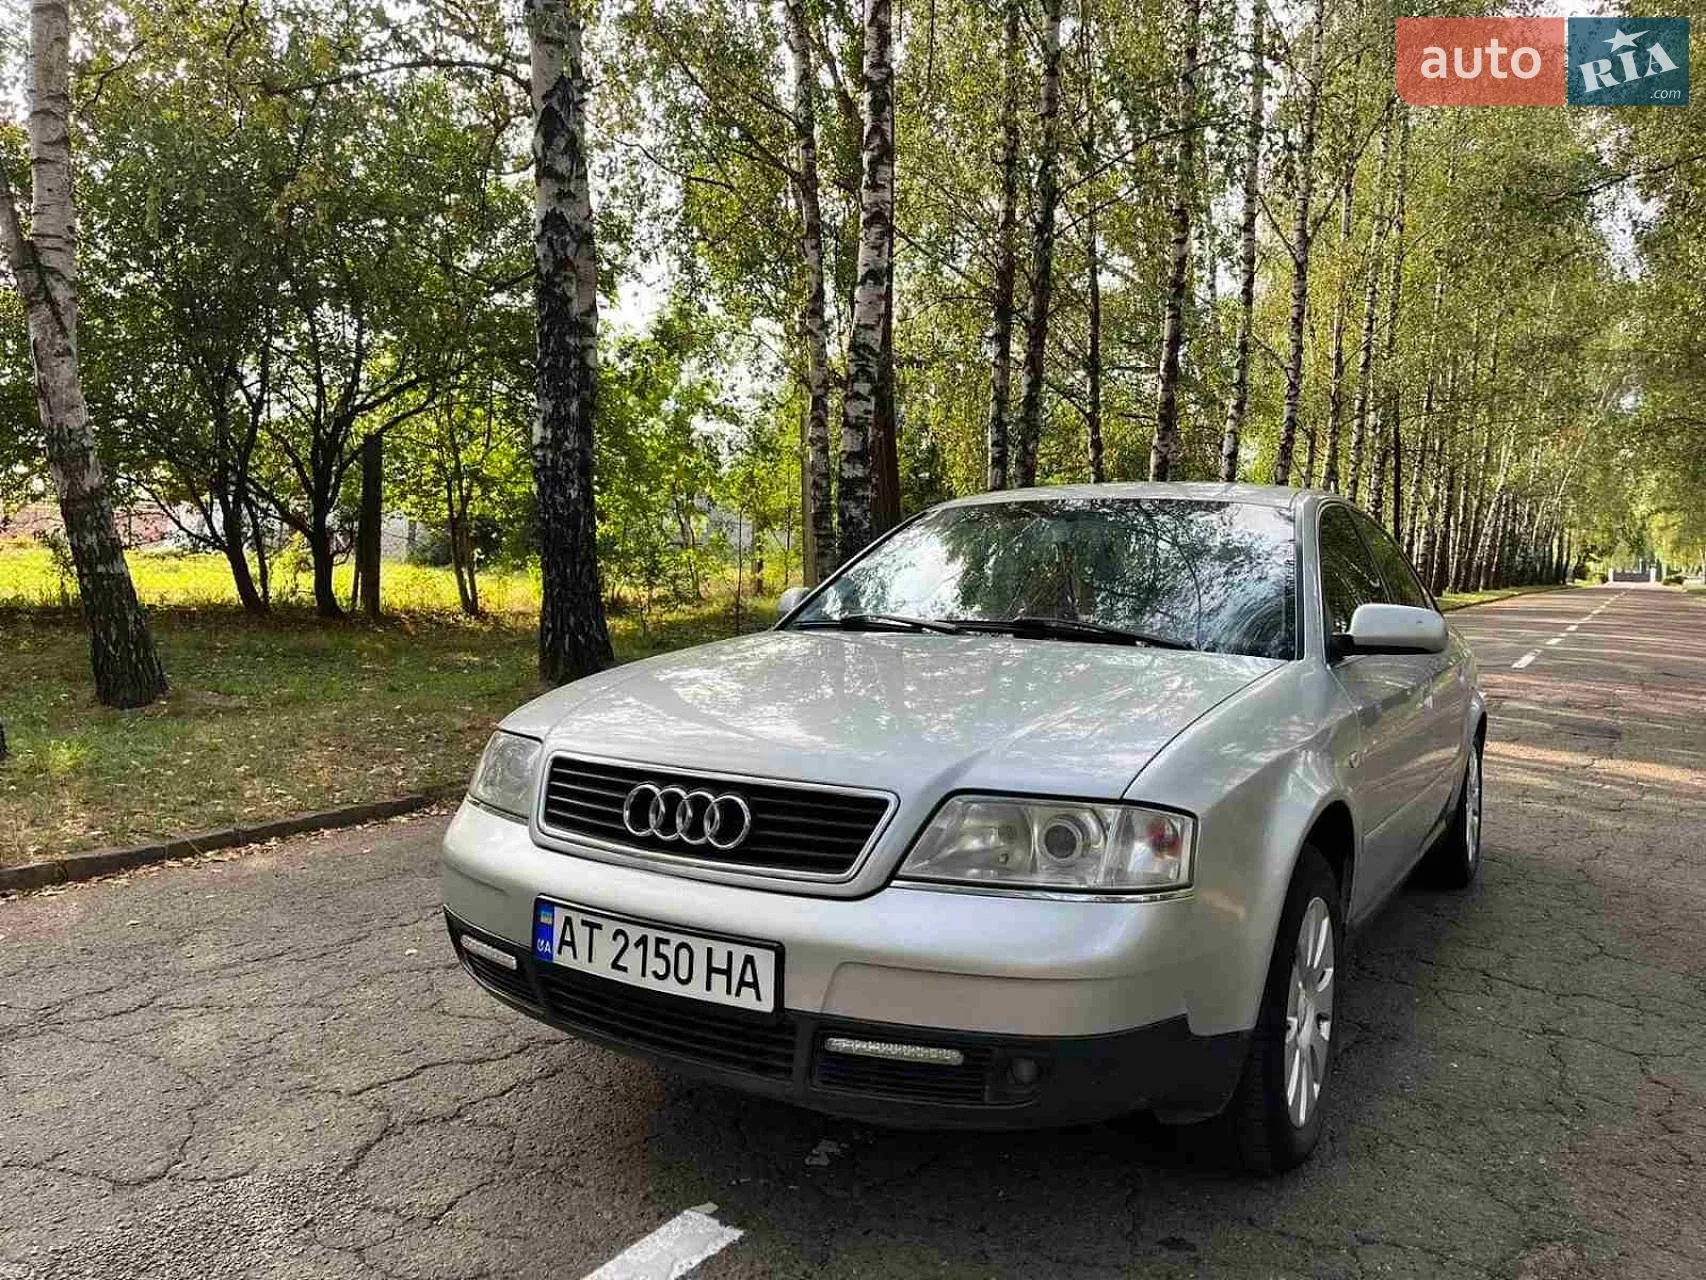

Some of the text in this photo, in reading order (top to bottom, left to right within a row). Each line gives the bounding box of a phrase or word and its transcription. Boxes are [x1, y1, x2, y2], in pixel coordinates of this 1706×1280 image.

[557, 915, 762, 1002] AT 2150 HA
